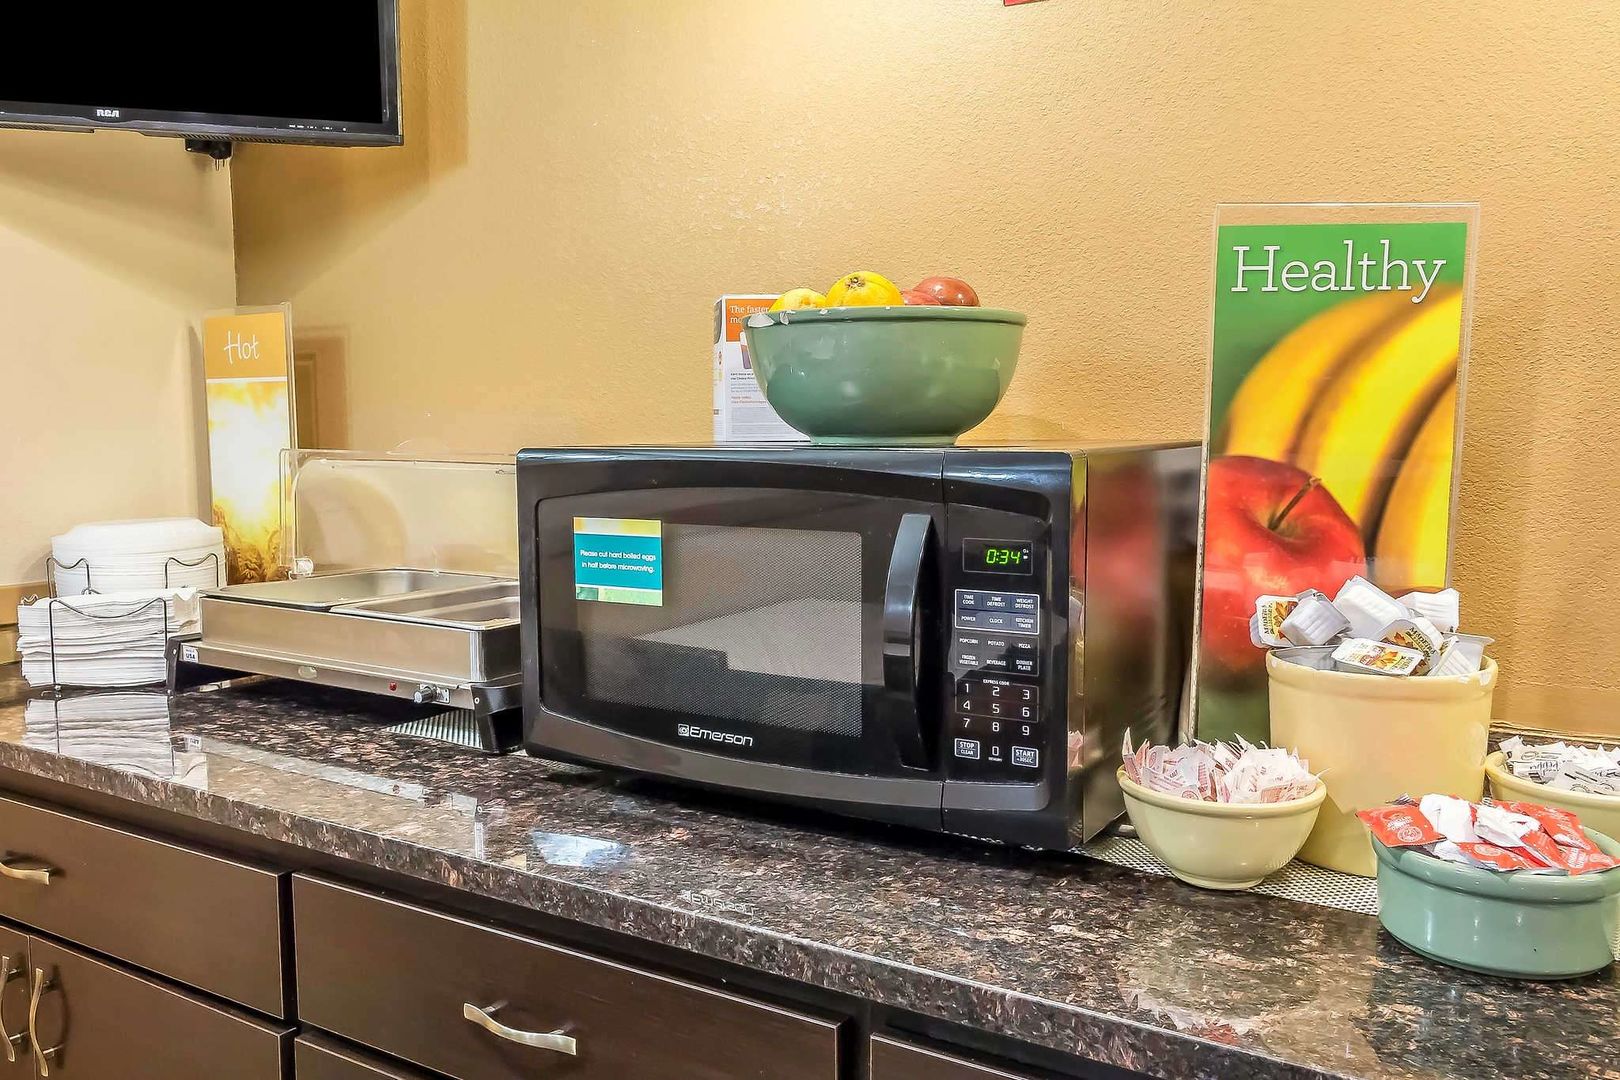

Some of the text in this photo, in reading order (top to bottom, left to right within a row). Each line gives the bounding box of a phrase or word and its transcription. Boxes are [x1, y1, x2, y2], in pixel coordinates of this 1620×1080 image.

[96, 109, 120, 118] RCA
[1231, 239, 1447, 304] Healthy
[730, 305, 769, 313] The faster
[224, 330, 260, 365] Hot
[580, 549, 598, 557] Please
[623, 552, 641, 560] boiled
[641, 554, 656, 562] eggs
[986, 549, 1021, 564] 0:34
[599, 562, 617, 570] before
[617, 564, 655, 574] microwaving.
[965, 683, 969, 693] 1
[992, 686, 999, 697] 2
[1022, 689, 1030, 700] 3
[963, 700, 970, 710] 4
[992, 703, 999, 714] 5
[1022, 707, 1029, 717] 6
[963, 718, 970, 728] 7
[992, 721, 999, 732] 8
[1022, 725, 1029, 736] 9
[690, 726, 753, 747] Emerson
[992, 746, 999, 756] 0
[1015, 749, 1034, 757] START
